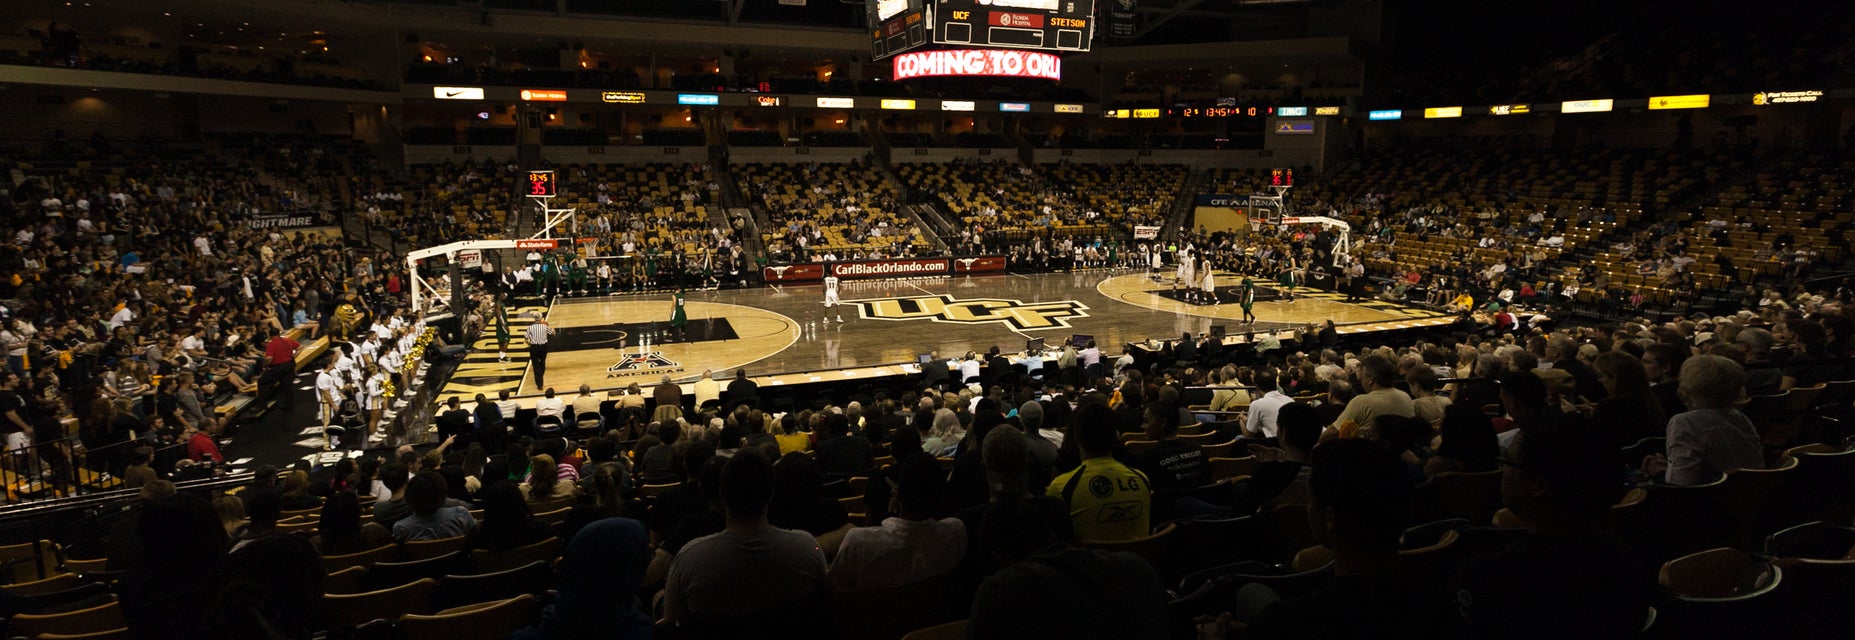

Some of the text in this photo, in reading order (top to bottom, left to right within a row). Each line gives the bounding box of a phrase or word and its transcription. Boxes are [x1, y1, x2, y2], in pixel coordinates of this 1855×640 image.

[953, 11, 970, 20] UCF
[1050, 17, 1086, 28] STETSON
[897, 50, 986, 77] COMING
[991, 50, 1023, 76] TO
[1183, 108, 1192, 117] 12
[1247, 107, 1256, 116] 10
[531, 182, 546, 195] 35
[248, 216, 313, 229] IGHTMARE
[459, 252, 479, 262] SPN
[835, 261, 945, 276] CarlBlackOrlando.com
[838, 294, 1090, 332] UCF
[1117, 477, 1140, 492] LG
